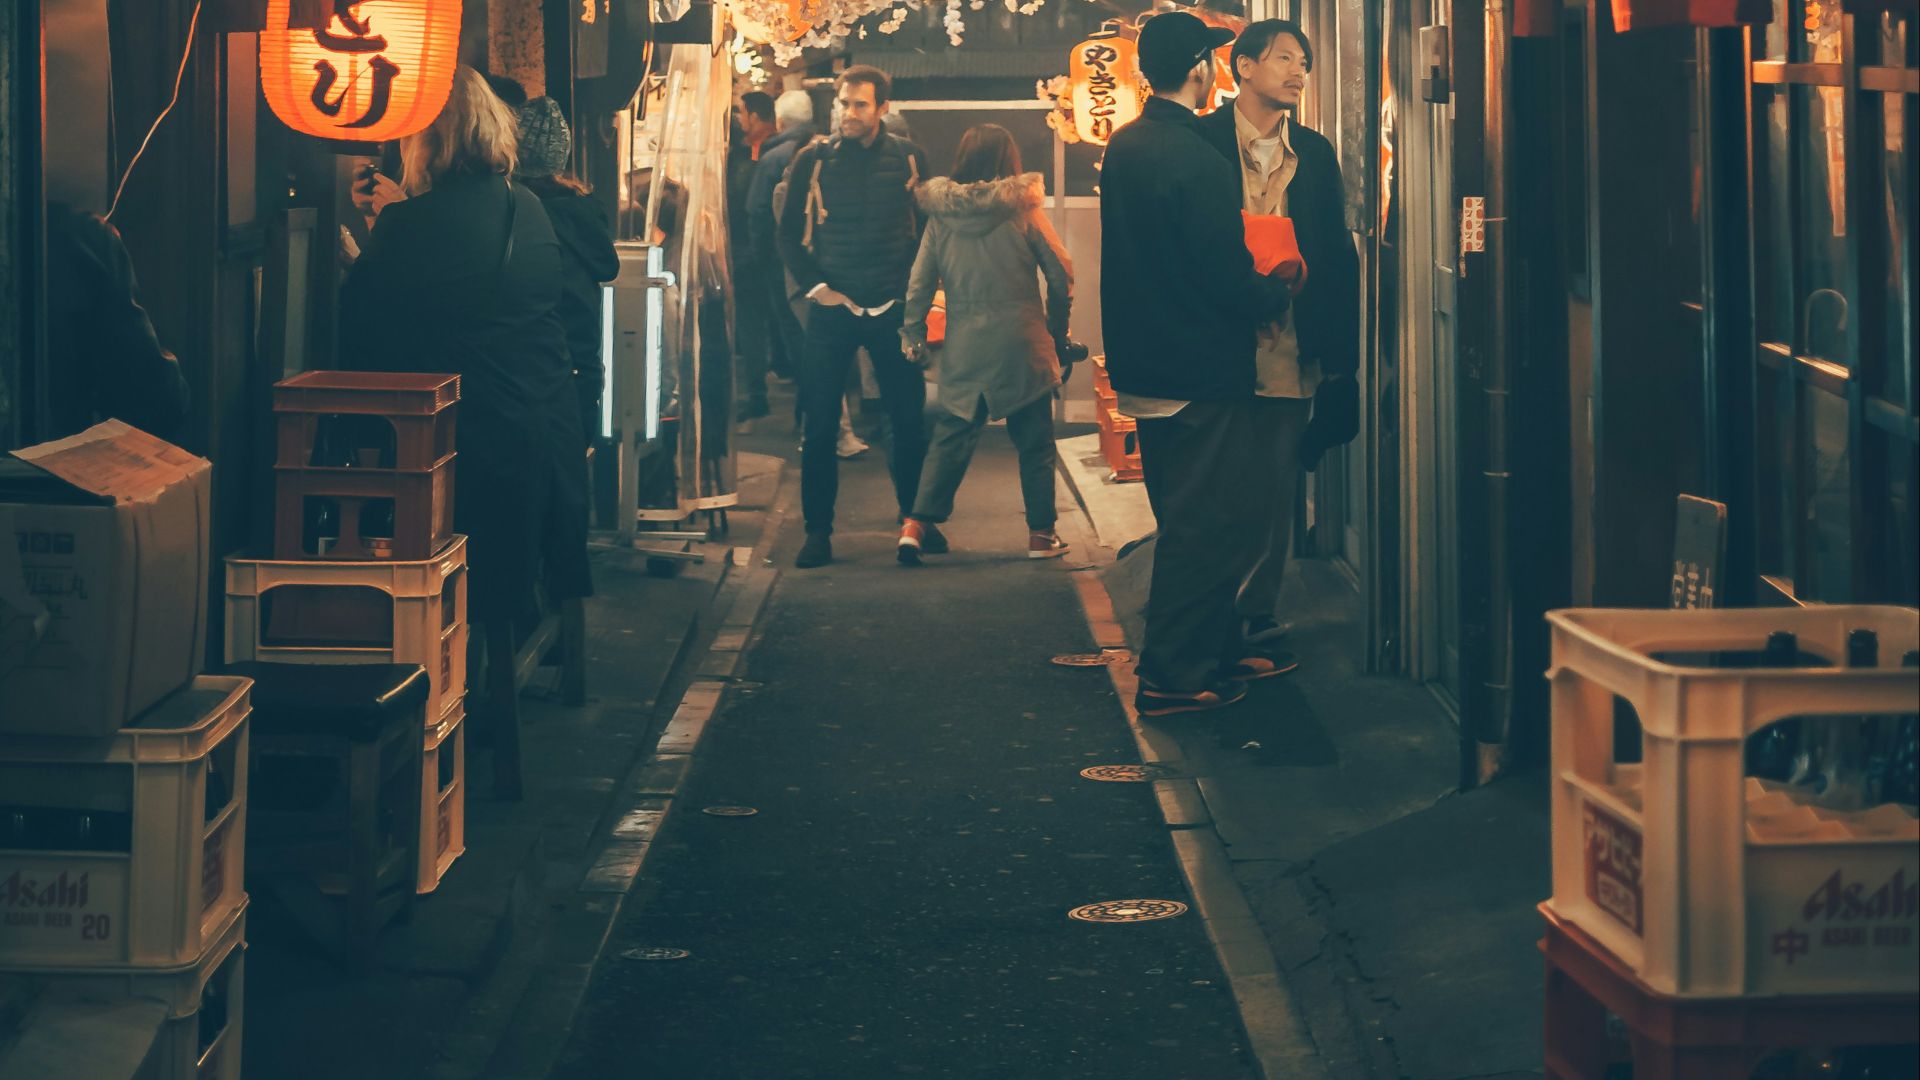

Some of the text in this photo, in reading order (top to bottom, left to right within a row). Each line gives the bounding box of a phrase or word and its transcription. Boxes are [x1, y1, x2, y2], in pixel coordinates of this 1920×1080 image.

[1084, 44, 1118, 140] やきとり
[0, 869, 89, 908] Asahi
[82, 914, 110, 940] 20
[1772, 928, 1809, 964] 中
